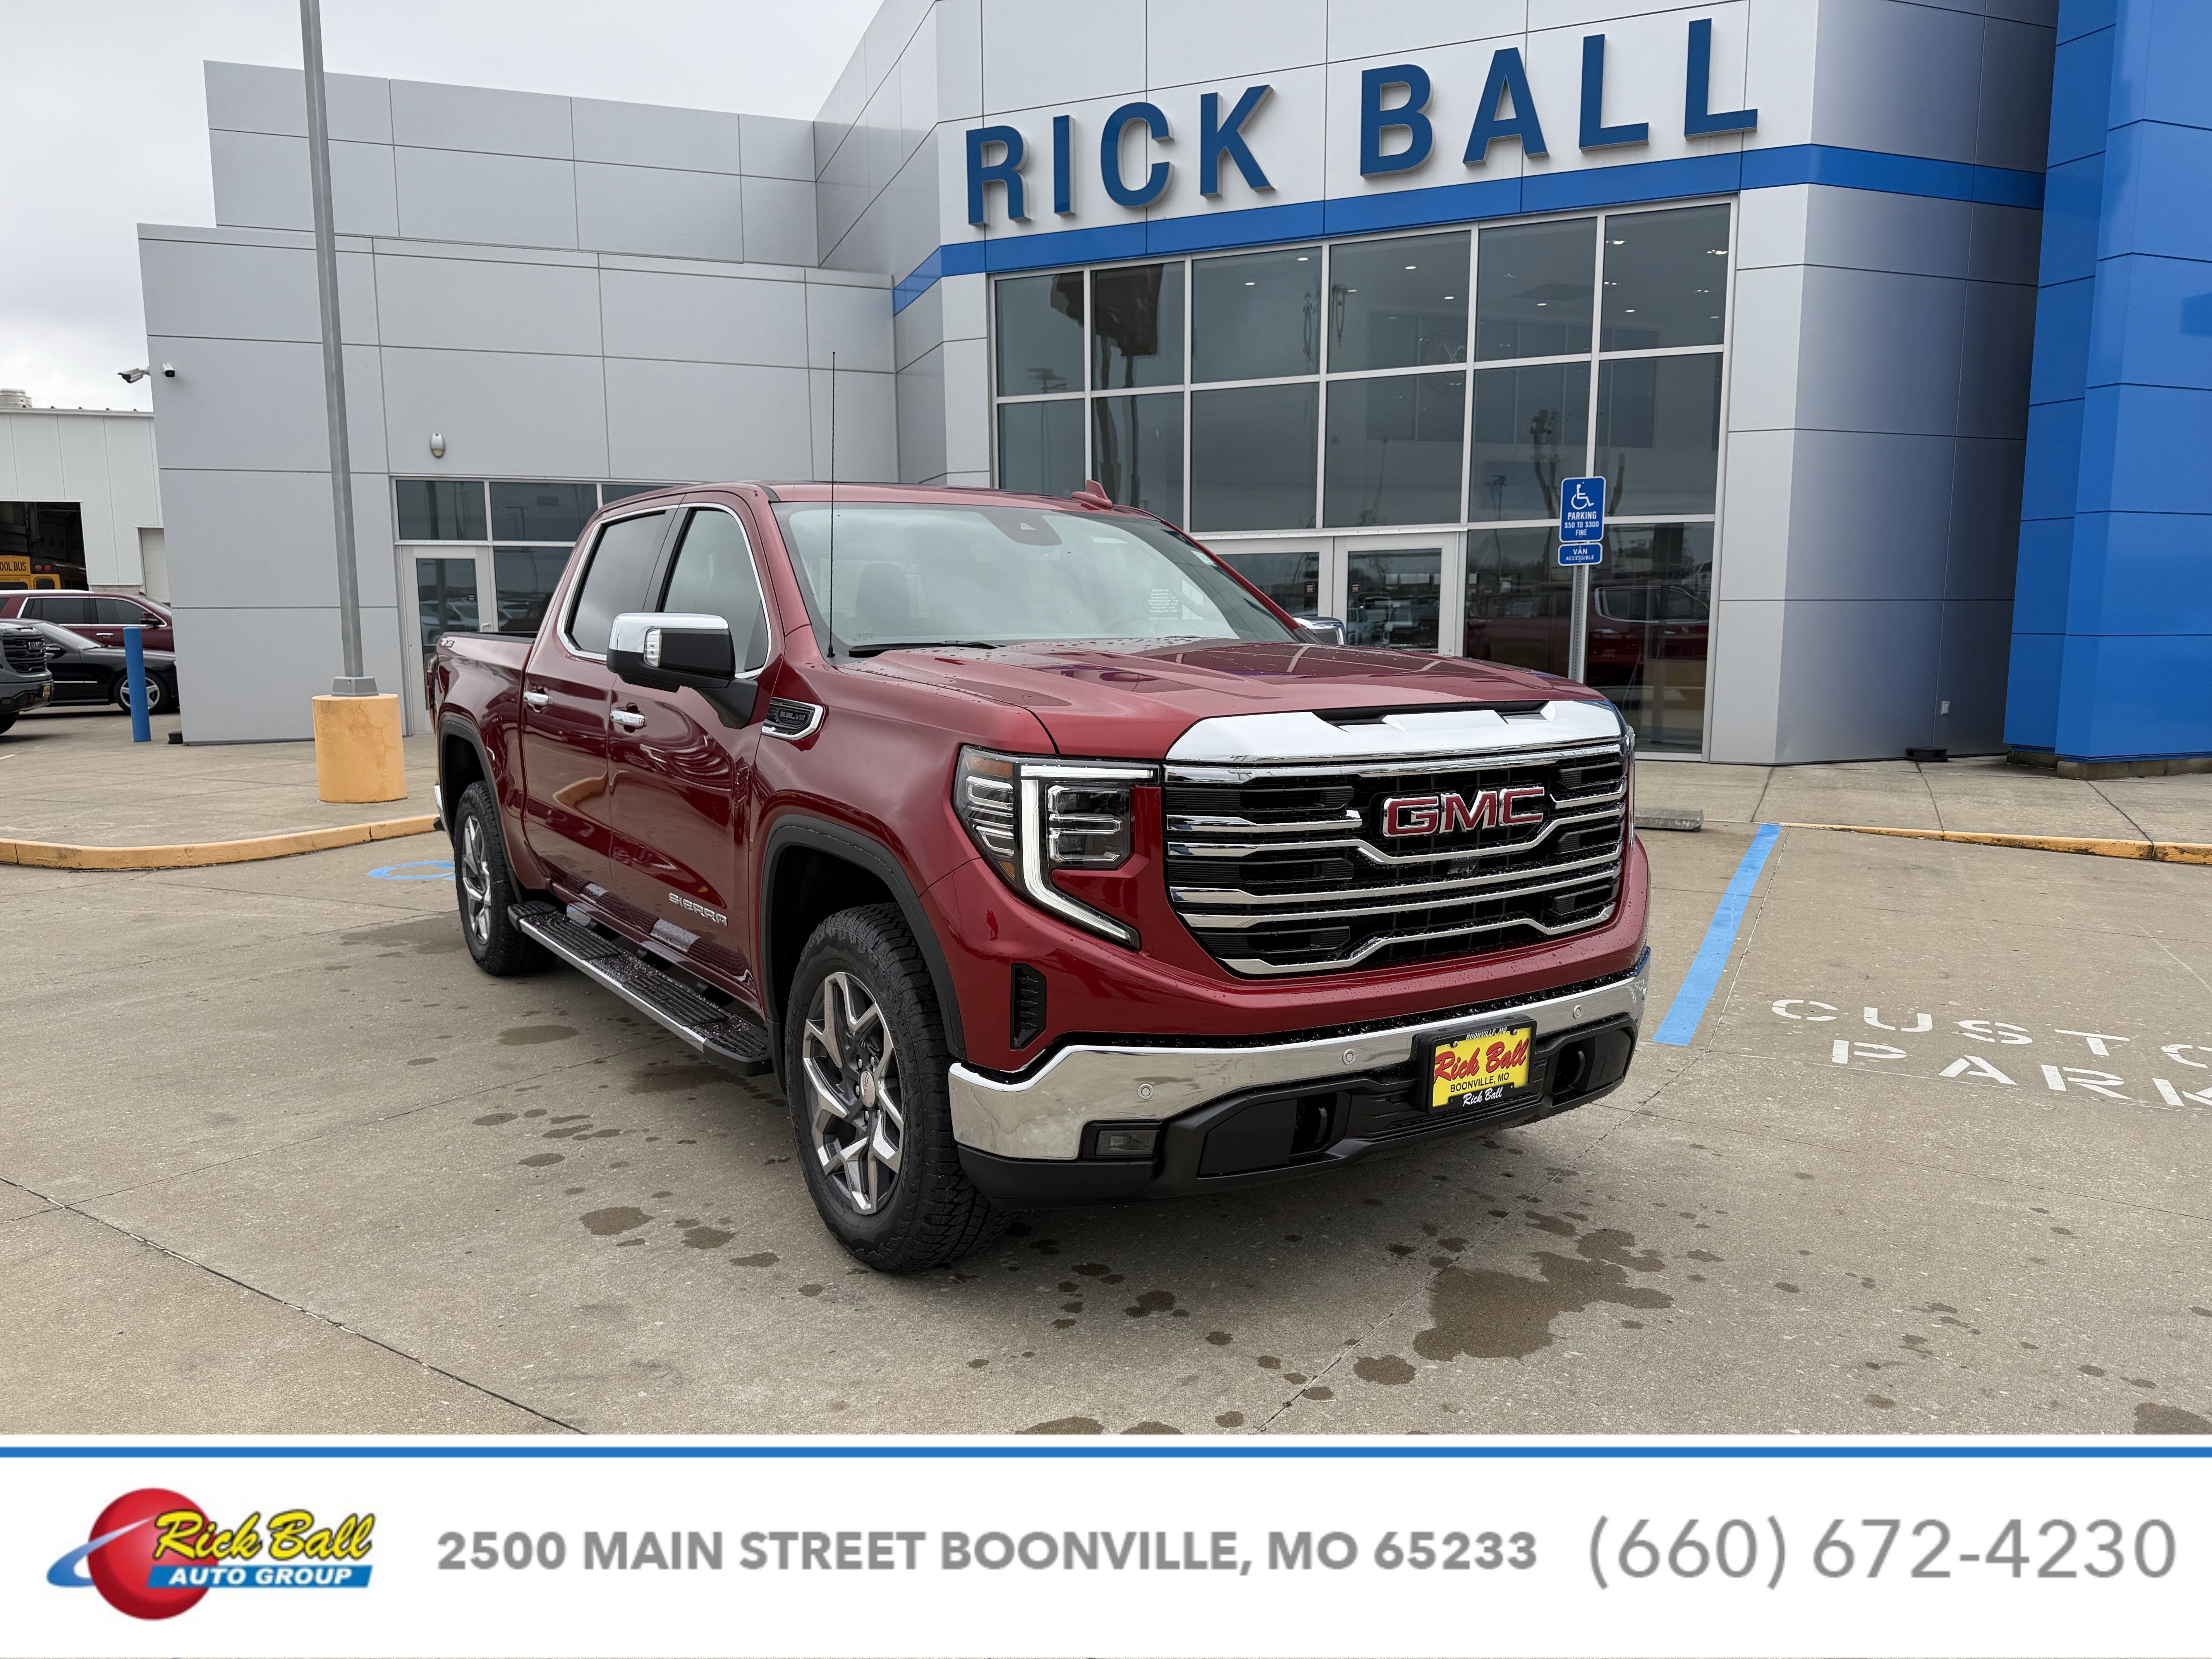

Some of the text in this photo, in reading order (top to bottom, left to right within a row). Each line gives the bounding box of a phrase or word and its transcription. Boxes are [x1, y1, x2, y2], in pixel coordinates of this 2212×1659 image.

[966, 18, 1759, 227] RICK BALL
[1568, 511, 1597, 520] PARKING
[14, 562, 26, 571] BUS
[1382, 786, 1545, 837] GMC
[668, 892, 728, 927] SIERRA
[1466, 1029, 1496, 1040] BOONVILLE,
[1772, 999, 2212, 1068] CUSTO
[1434, 1038, 1530, 1084] Rick Ball
[1832, 1039, 2212, 1106] PARK
[1450, 1072, 1510, 1093] BOONVILLE, MO
[1463, 1086, 1503, 1107] Rick Ball
